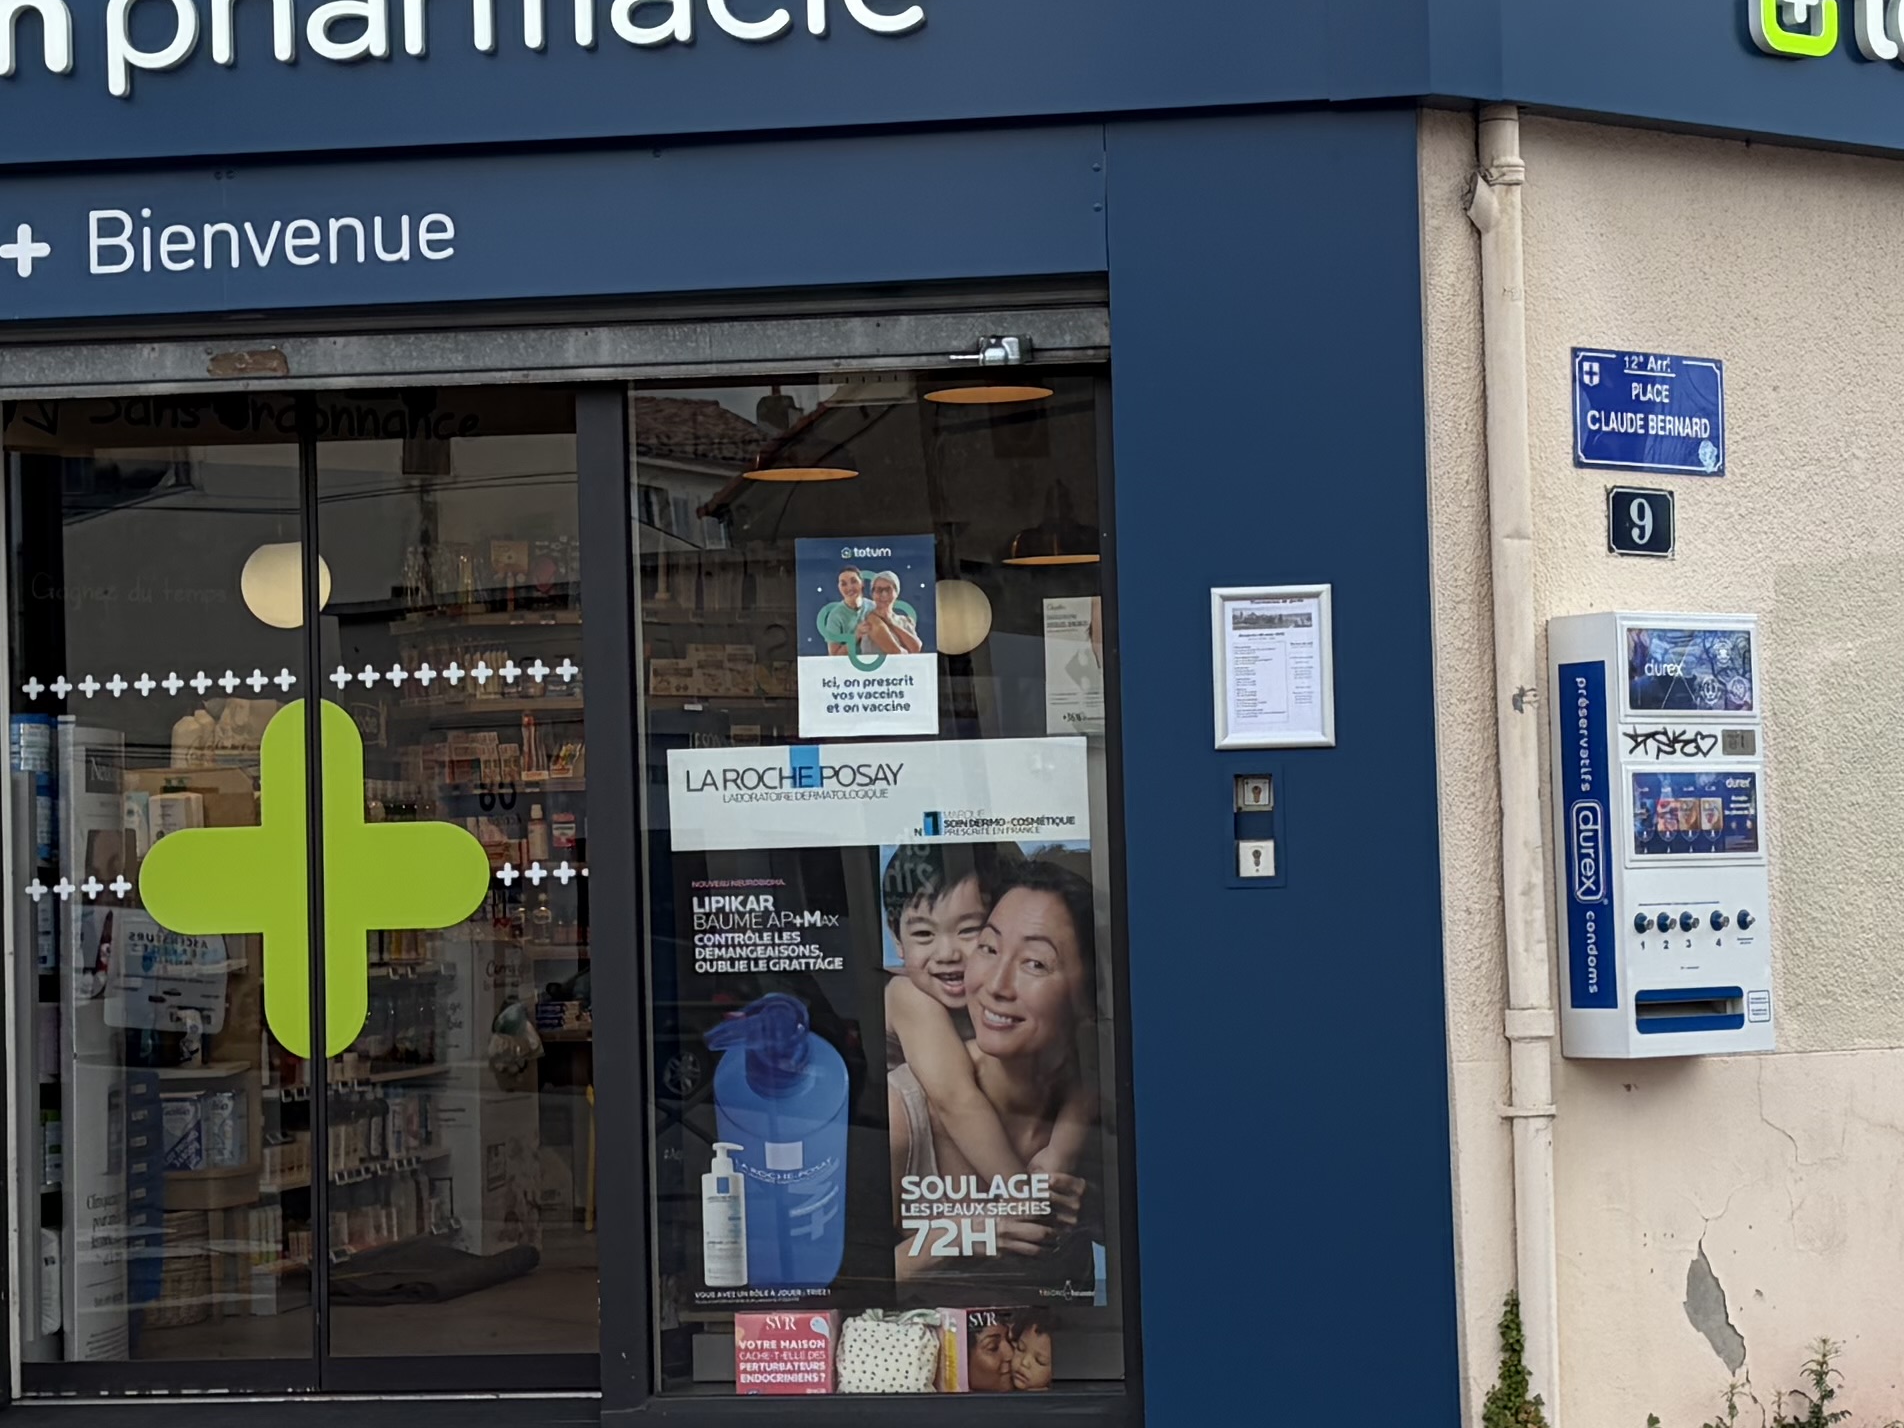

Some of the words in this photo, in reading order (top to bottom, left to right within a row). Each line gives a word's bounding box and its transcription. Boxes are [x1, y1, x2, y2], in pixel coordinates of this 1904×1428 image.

[89, 206, 457, 276] Bienvenue
[1631, 382, 1670, 403] PLACE
[1587, 410, 1645, 433] CLAUDE
[1648, 417, 1710, 438] BERNARD
[1630, 498, 1653, 544] 9
[853, 547, 891, 558] totum
[1644, 659, 1682, 676] durex
[822, 677, 840, 689] Ici,
[844, 679, 860, 688] on
[863, 675, 914, 689] prescrit
[832, 691, 855, 700] vos
[857, 688, 904, 699] vaccins
[826, 703, 840, 713] et
[843, 703, 859, 713] on
[862, 700, 911, 712] vaccine
[1575, 677, 1590, 793] préservatifs
[686, 769, 719, 792] LA
[722, 766, 814, 791] ROCHE
[819, 762, 904, 788] POSAY
[723, 791, 793, 803] LABORATOIRE
[795, 788, 888, 801] DERMATOLOGIQUE
[1578, 809, 1600, 890] durex
[692, 894, 775, 913] LIPIKAR
[693, 912, 763, 930] BAUME
[694, 930, 772, 946] CONTRÔLE
[774, 931, 801, 944] LES
[1585, 910, 1598, 994] condoms
[695, 960, 747, 973] OUBLIE
[750, 959, 768, 971] LE
[769, 957, 843, 971] GRATTAGE
[901, 1173, 1049, 1200] SOULAGE
[901, 1204, 930, 1216] LES
[933, 1202, 985, 1215] PEAUX
[987, 1199, 1051, 1215] SÈCHES
[902, 1218, 996, 1256] 72H
[765, 1315, 796, 1330] SVR
[969, 1312, 997, 1326] SVR
[739, 1340, 777, 1349] VOTRE
[780, 1339, 825, 1349] MAISON
[808, 1351, 825, 1359] DES
[739, 1362, 825, 1370] PERTURBATEURS
[740, 1373, 818, 1383] ENDOCRINIENS
